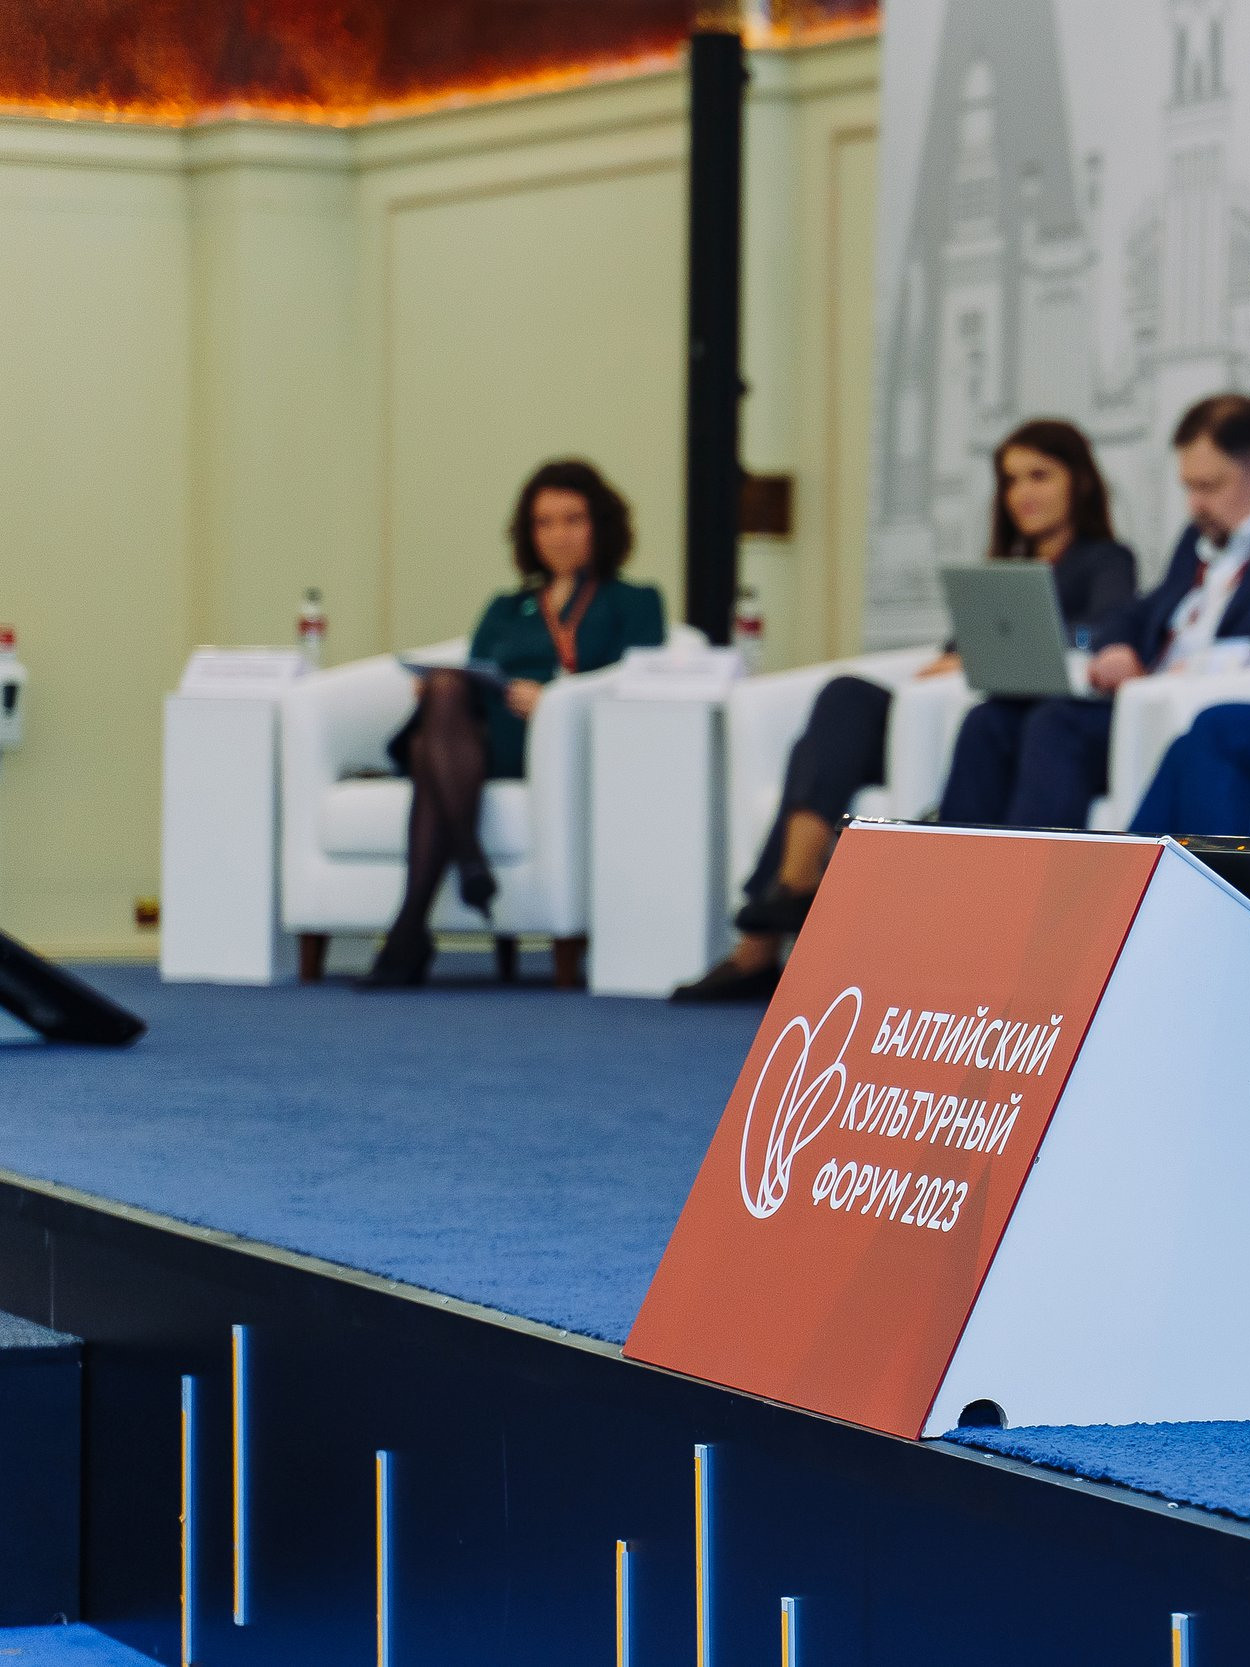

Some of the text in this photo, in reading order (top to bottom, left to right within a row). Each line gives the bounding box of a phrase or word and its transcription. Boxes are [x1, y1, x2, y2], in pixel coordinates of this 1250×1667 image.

[871, 1006, 1064, 1076] БАЛТИЙСКИЙ
[839, 1082, 1024, 1155] КУЛЬТУРНЫЙ
[811, 1158, 969, 1233] ФОРУМ 2023
